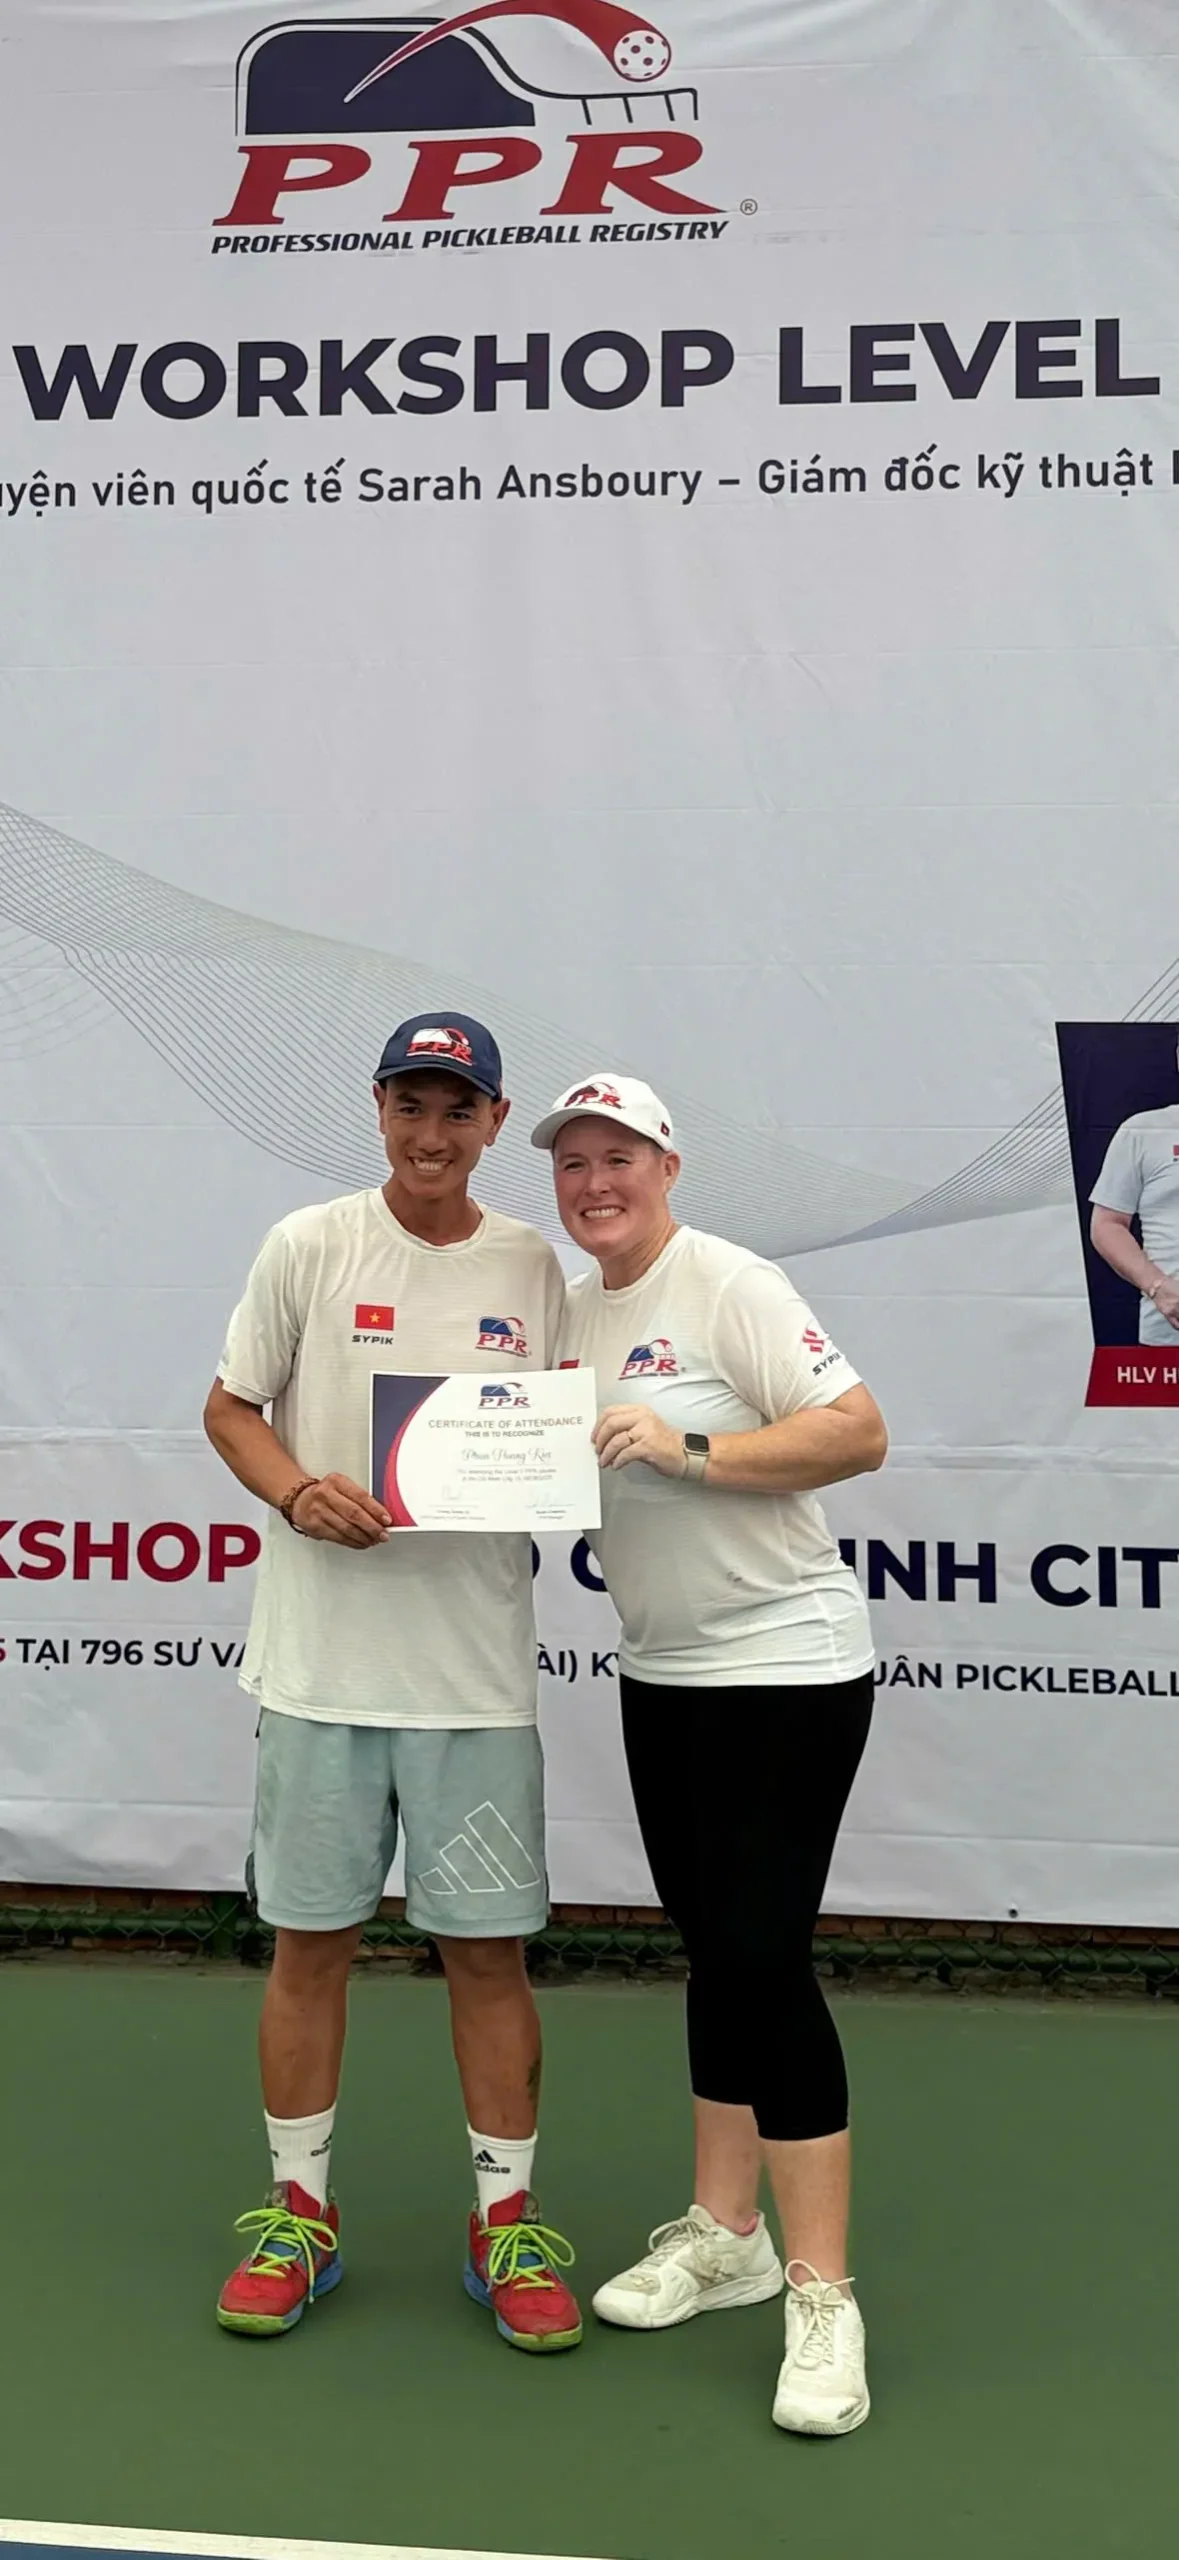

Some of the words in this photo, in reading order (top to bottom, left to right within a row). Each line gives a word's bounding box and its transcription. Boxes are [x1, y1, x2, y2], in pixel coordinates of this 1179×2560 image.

[212, 131, 728, 227] PPR
[211, 232, 414, 255] PROFESSIONAL
[422, 225, 581, 248] PICKLEBALL
[590, 219, 730, 243] REGISTRY
[12, 328, 735, 421] WORKSHOP
[778, 318, 1161, 405] LEVEL
[0, 469, 76, 517] yện
[92, 468, 175, 507] viên
[192, 458, 289, 515] quốc
[304, 457, 346, 503] tế
[358, 466, 482, 502] Sarah
[497, 463, 703, 506] Ansboury
[757, 454, 867, 495] Giám
[884, 443, 961, 492] đốc
[976, 451, 1024, 498] kỹ
[1039, 447, 1154, 498] thuật
[407, 1042, 472, 1061] PPR
[351, 1334, 394, 1346] SYPIK
[476, 1333, 528, 1354] PPR
[620, 1358, 678, 1378] PPR
[1117, 1366, 1157, 1384] HLV
[1163, 1367, 1179, 1384] H
[478, 1396, 531, 1408] PPR
[428, 1419, 494, 1429] CERTIFICATE
[498, 1419, 512, 1428] OF
[515, 1415, 583, 1428] ATTENDANCE
[502, 1429, 544, 1438] RECOGNIZE
[1030, 1544, 1179, 1609] CIT
[16, 1638, 69, 1671] TẠI
[81, 1639, 143, 1665] 796
[153, 1637, 203, 1667] SƯ
[956, 1663, 1179, 1697] PICKLEBALL
